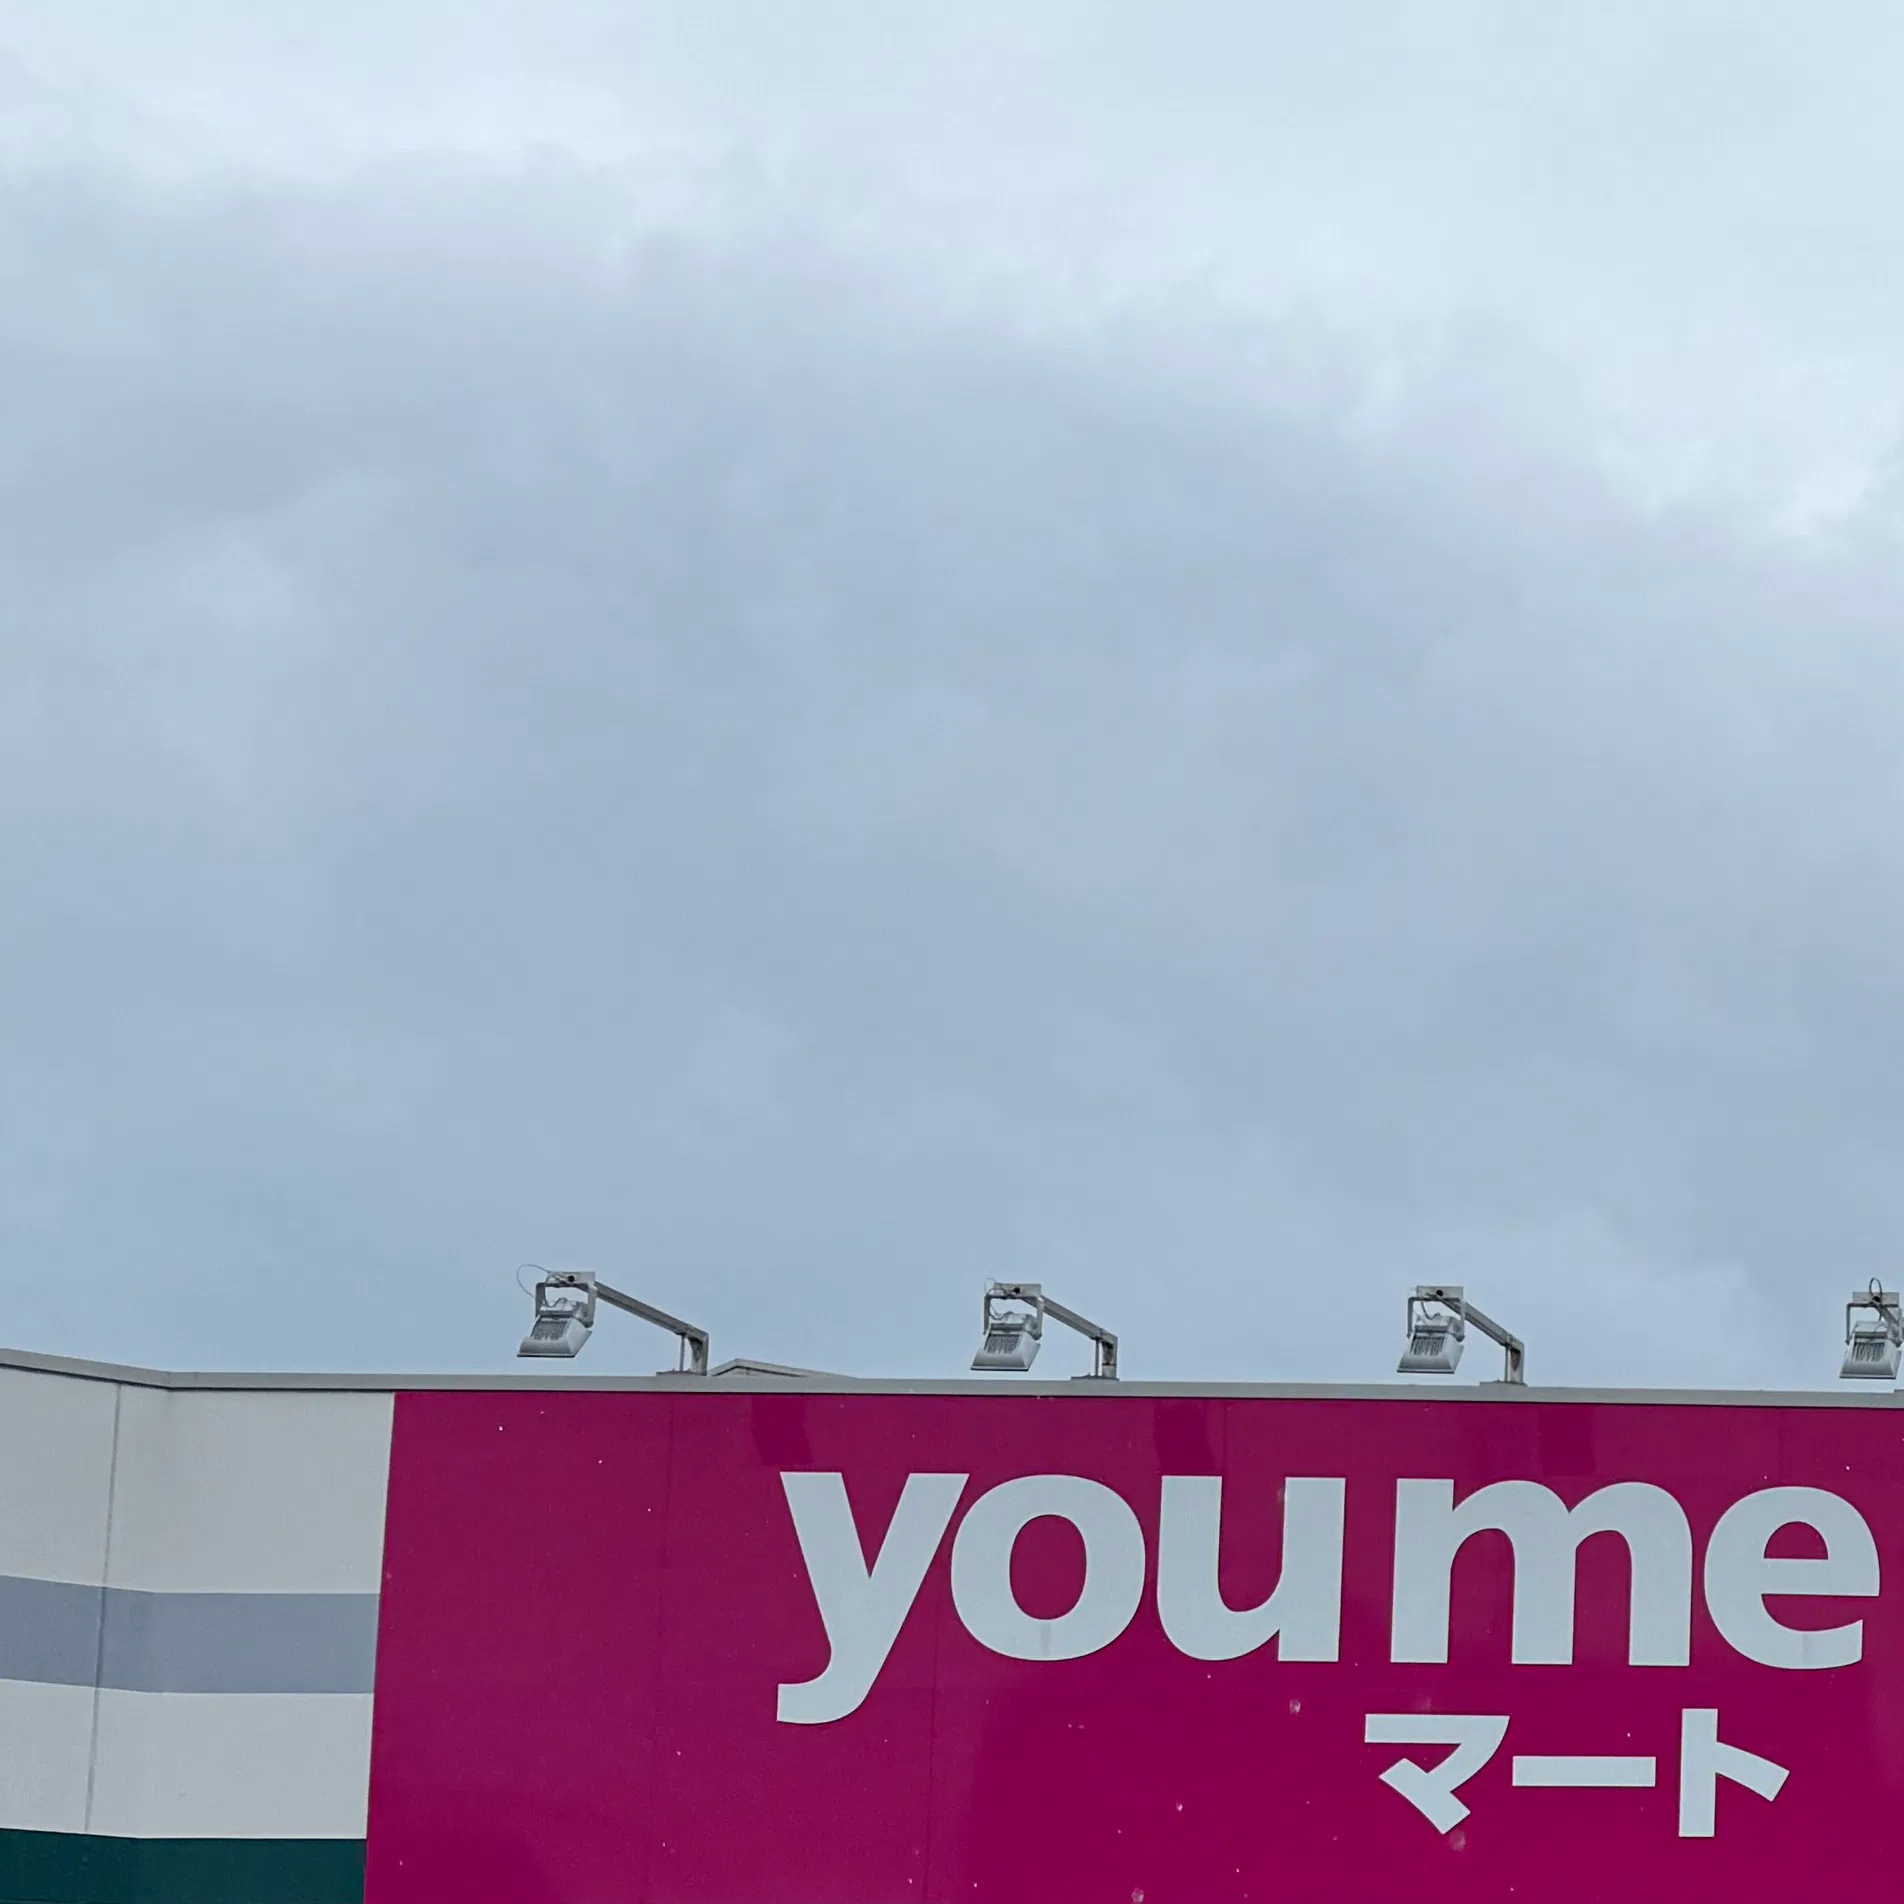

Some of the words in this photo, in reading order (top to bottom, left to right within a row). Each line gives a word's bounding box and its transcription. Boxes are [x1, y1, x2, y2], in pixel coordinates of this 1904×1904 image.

[776, 1471, 1880, 1724] youme
[1364, 1708, 1790, 1838] マート
